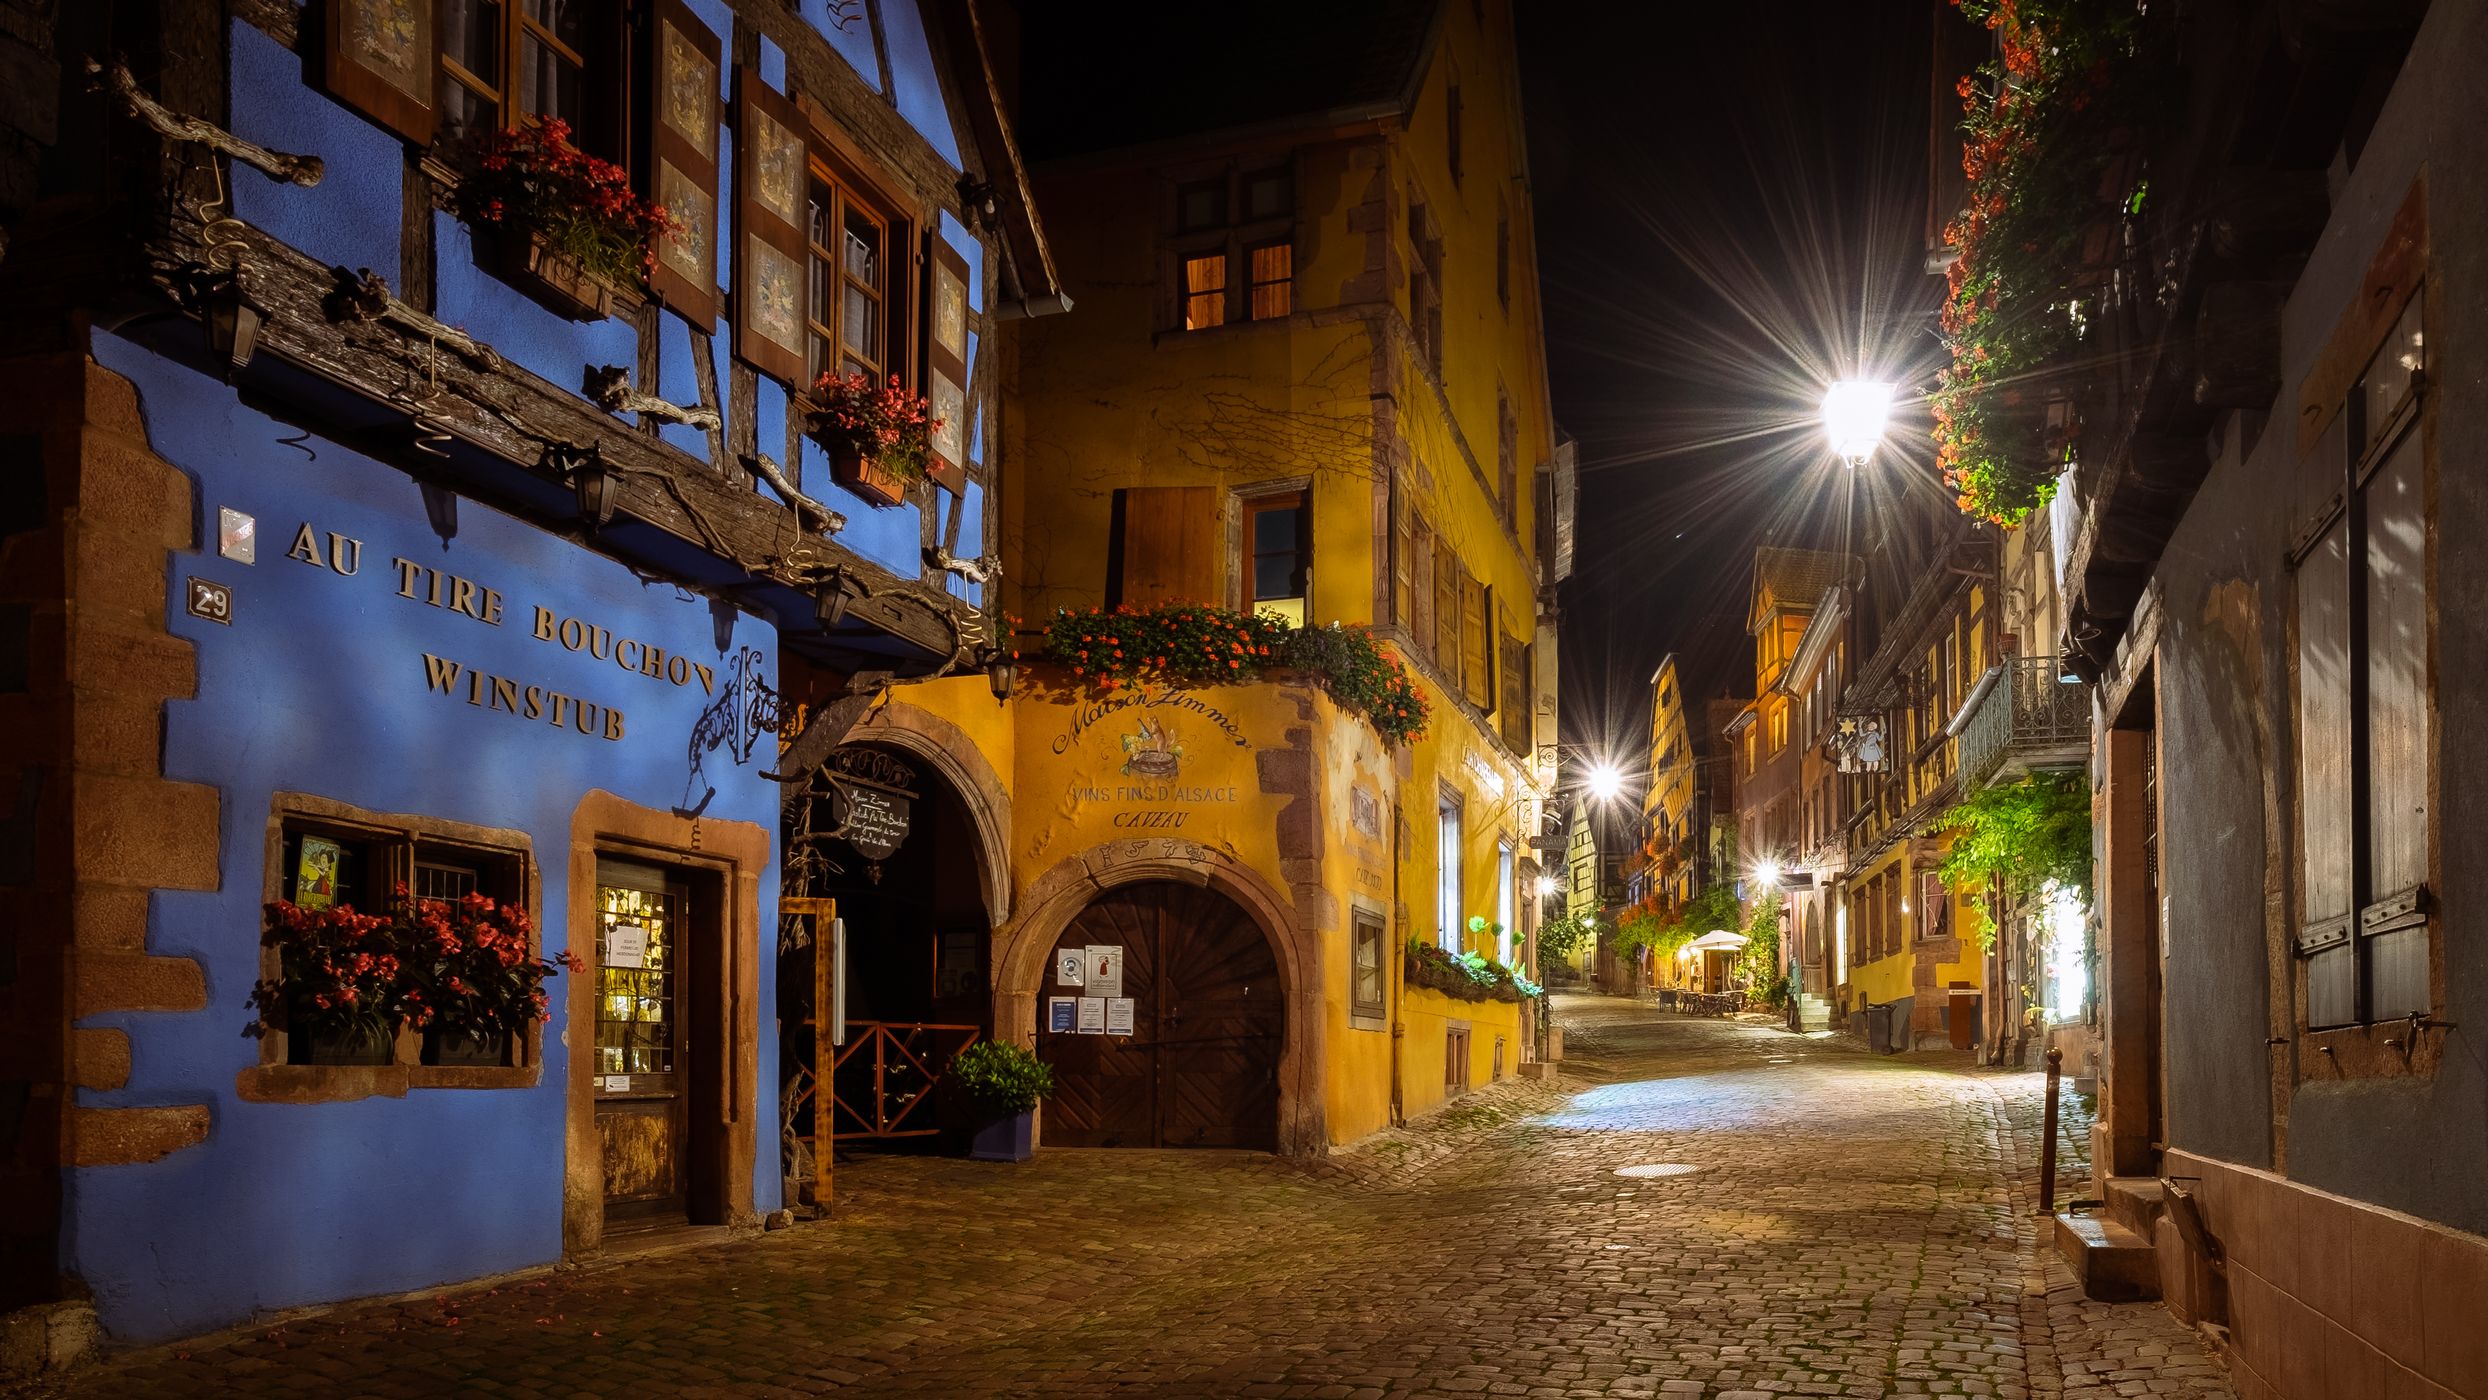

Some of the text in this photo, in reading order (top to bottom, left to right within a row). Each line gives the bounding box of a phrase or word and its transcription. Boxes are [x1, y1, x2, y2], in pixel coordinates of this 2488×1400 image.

[196, 585, 227, 616] 29
[286, 520, 364, 576] AU
[393, 556, 503, 626] TIRE
[532, 604, 716, 697] BOUCHON
[422, 653, 625, 741] WINSTUB
[1146, 689, 1252, 750] Zimmer
[1073, 786, 1110, 802] VINS
[1117, 786, 1152, 802] FINS
[1113, 811, 1190, 828] CAVEAU
[1530, 838, 1567, 849] PANAMA
